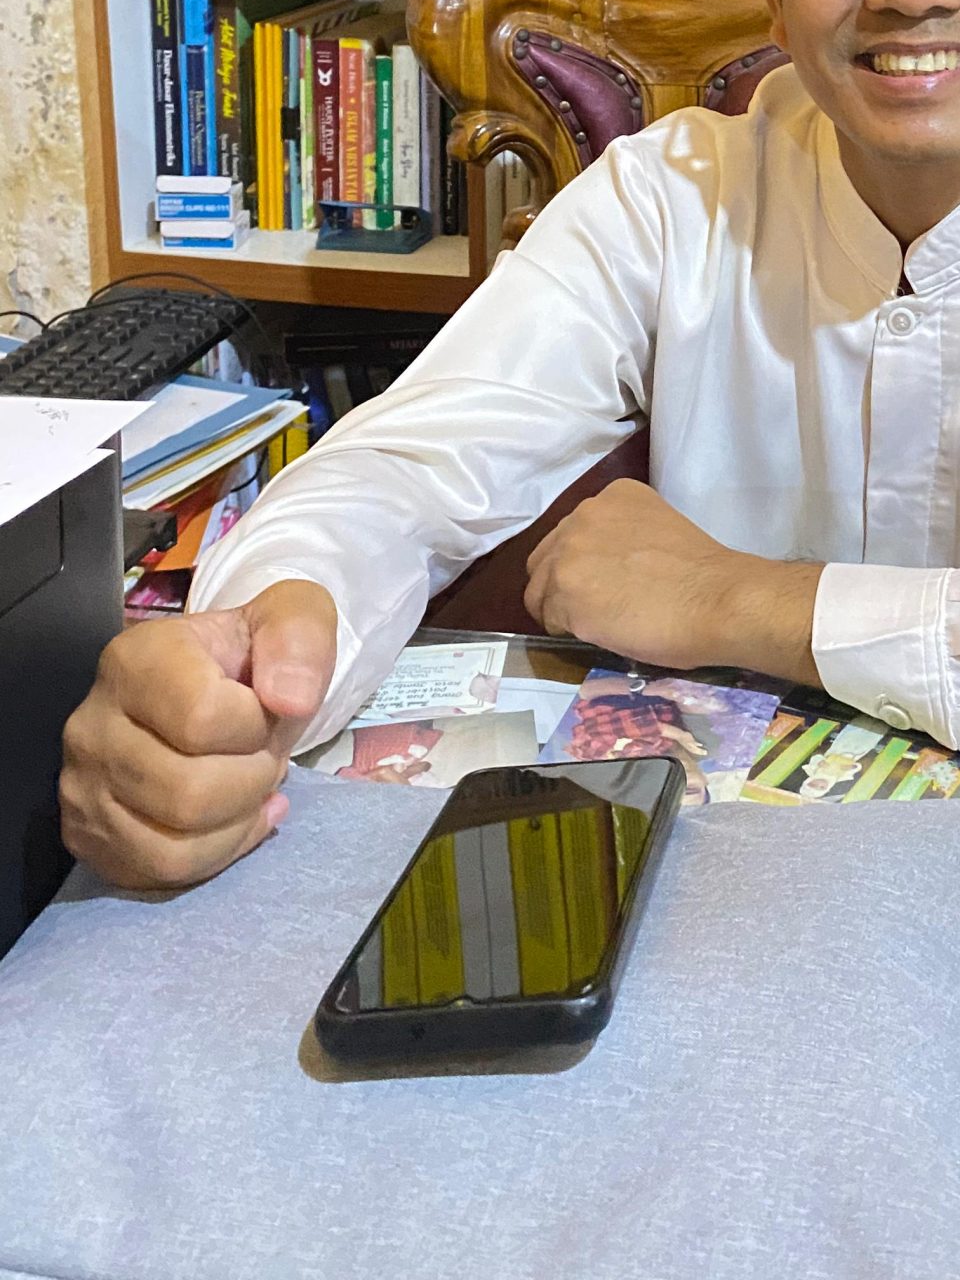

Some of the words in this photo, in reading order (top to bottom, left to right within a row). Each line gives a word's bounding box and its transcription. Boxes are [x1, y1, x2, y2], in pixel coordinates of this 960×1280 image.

[162, 49, 175, 102] Dasar-dasar
[324, 96, 334, 125] HARRY
[346, 110, 358, 142] ISLAM
[164, 103, 177, 166] Ekonometrika
[325, 128, 335, 162] POTTER
[346, 146, 358, 202] NUSANTAR
